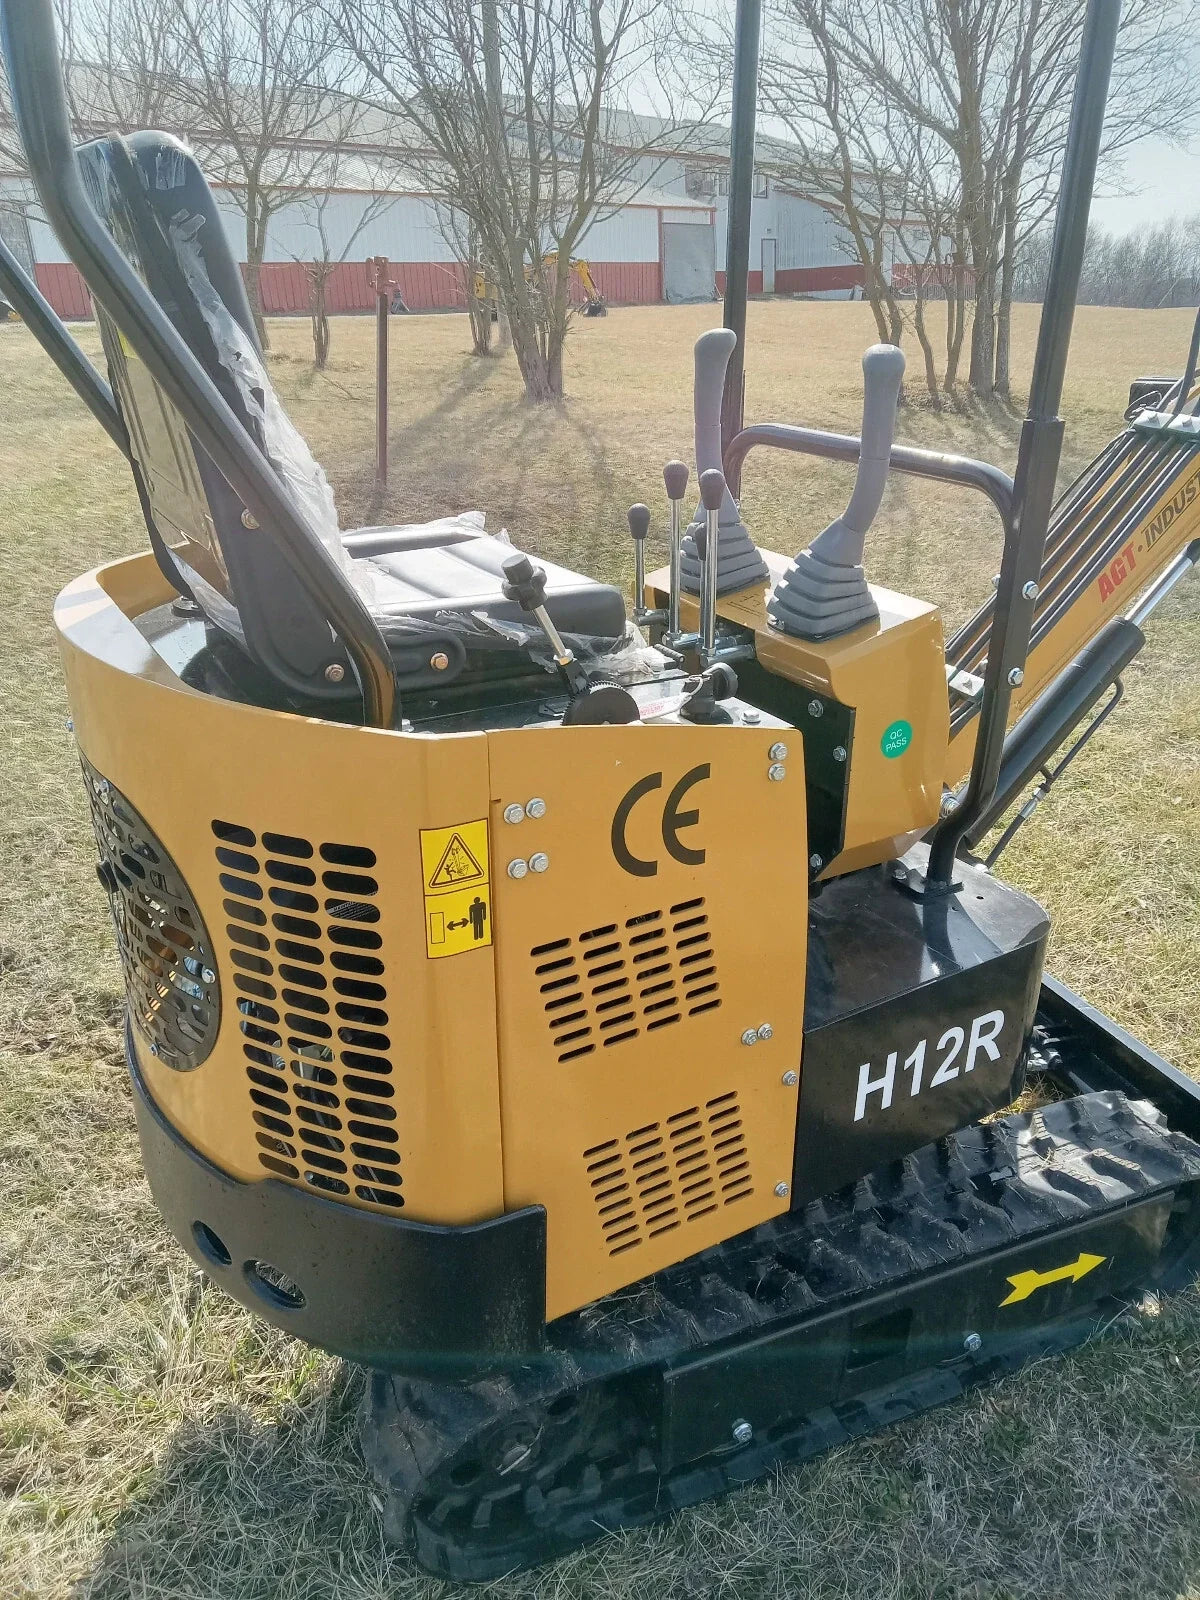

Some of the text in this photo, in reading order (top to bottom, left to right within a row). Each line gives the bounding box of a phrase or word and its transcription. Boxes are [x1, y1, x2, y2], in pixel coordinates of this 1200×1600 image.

[1097, 541, 1136, 603] AGT
[885, 736, 907, 752] PASS
[890, 728, 902, 740] QC
[611, 763, 711, 877] CE
[854, 1009, 1005, 1122] H12R
